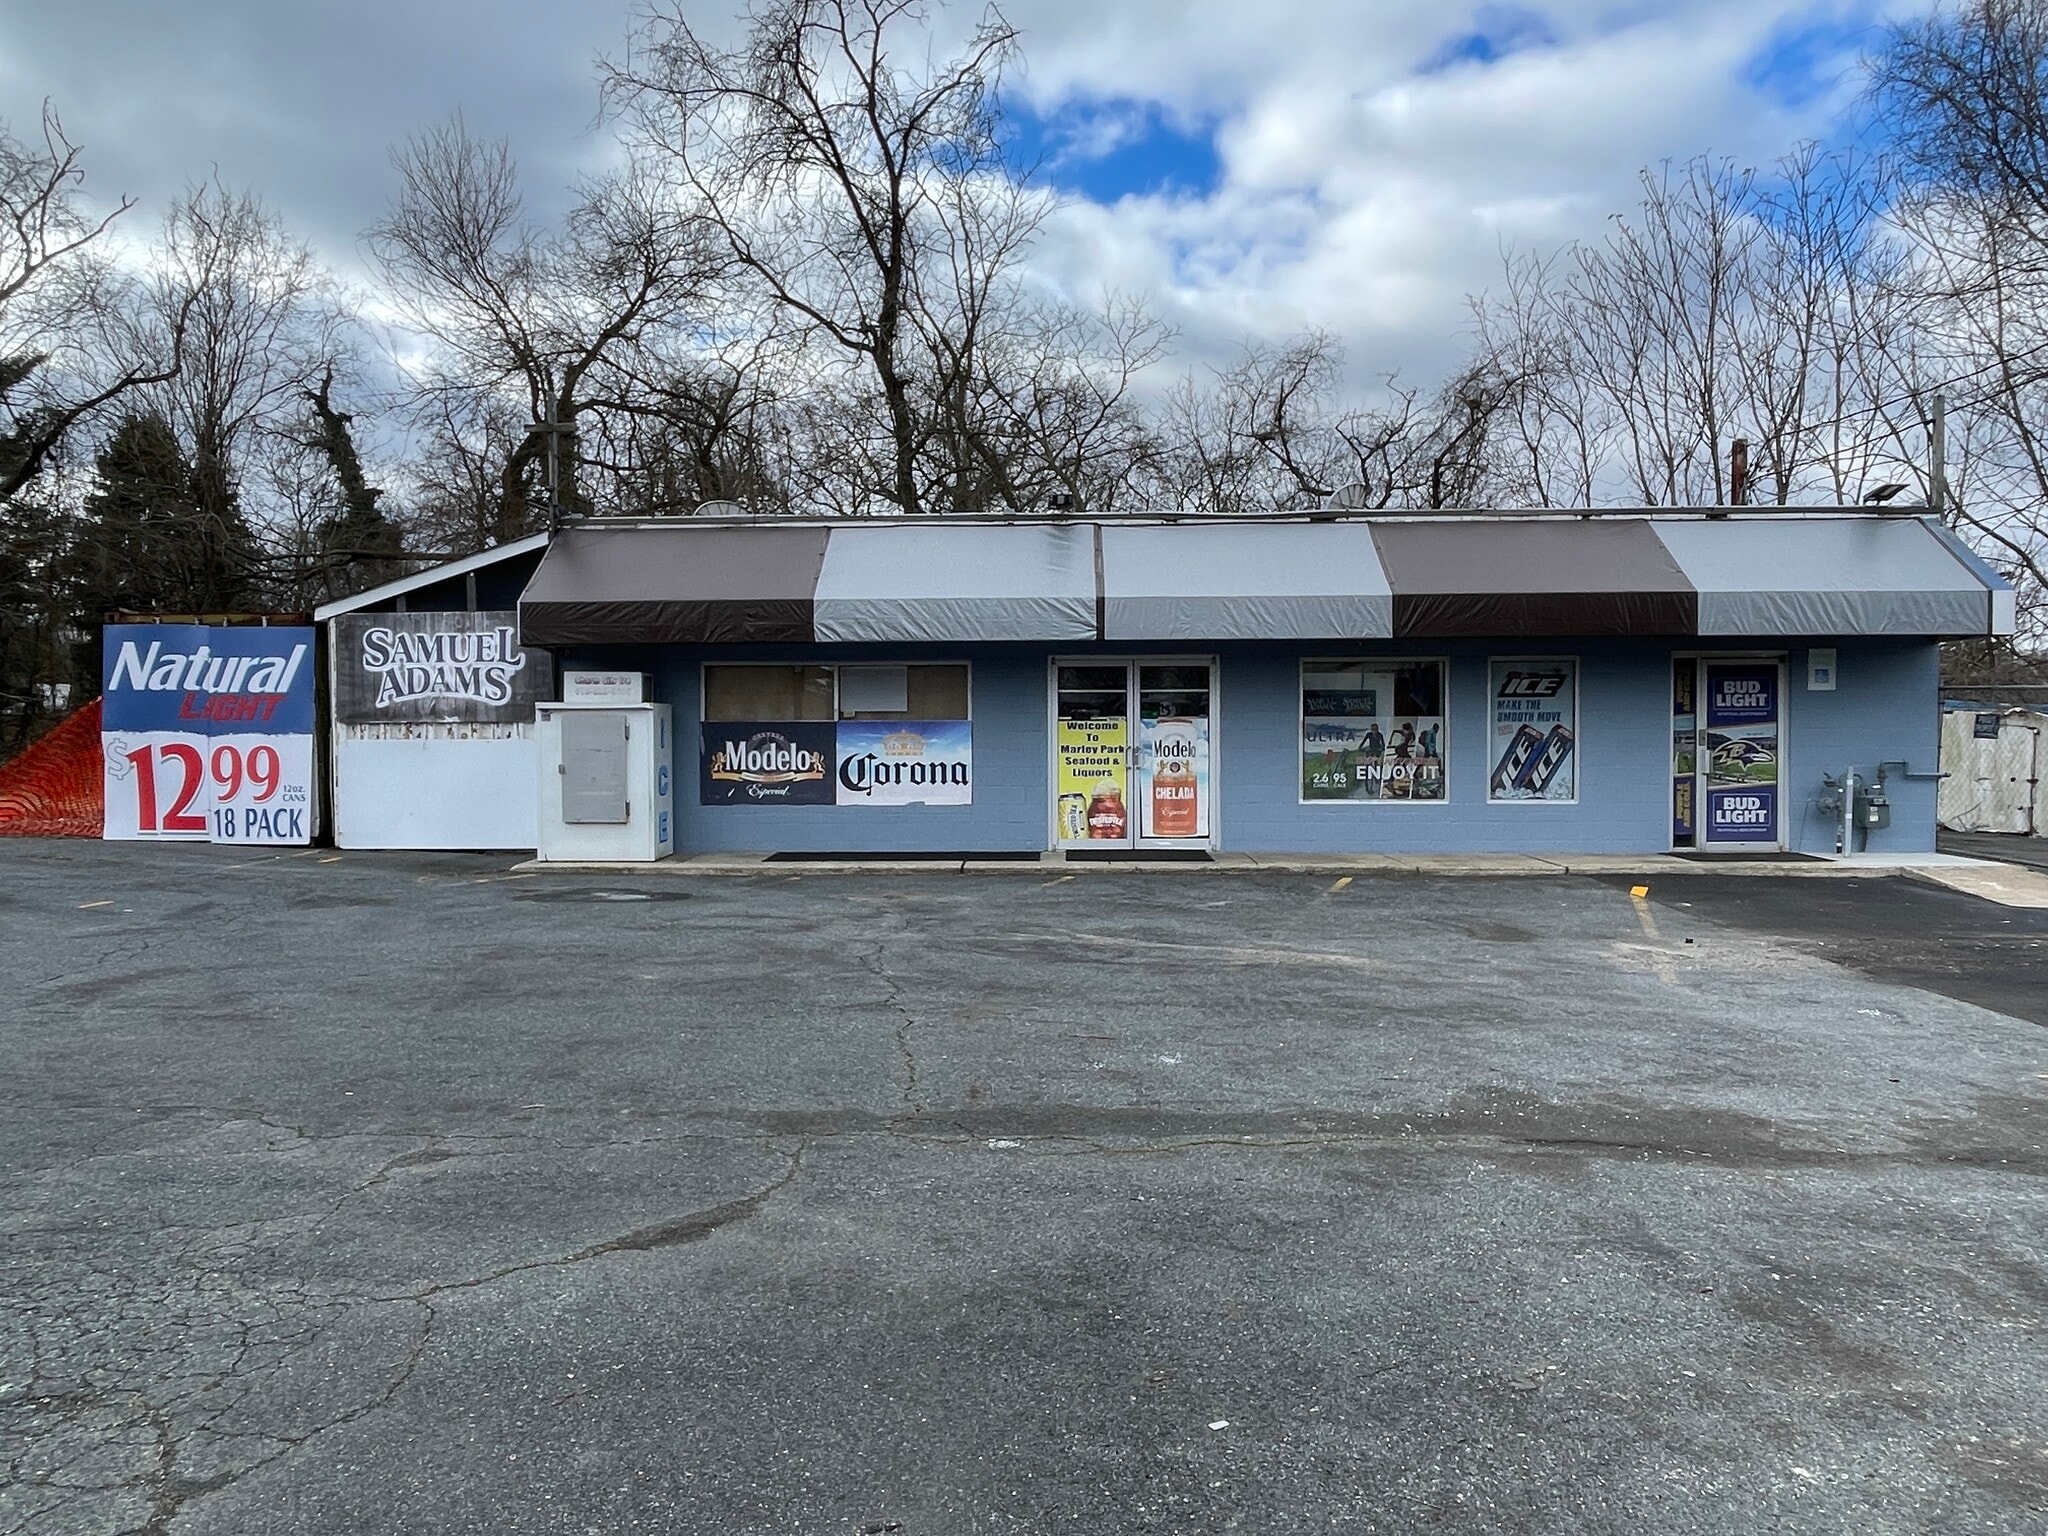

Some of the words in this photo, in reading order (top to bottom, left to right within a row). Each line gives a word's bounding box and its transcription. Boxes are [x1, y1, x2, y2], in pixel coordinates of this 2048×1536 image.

[362, 626, 526, 672] SAMUEL
[108, 641, 307, 694] Natural
[376, 664, 513, 708] ADAMS
[1504, 678, 1560, 694] ICE
[1723, 681, 1761, 694] BUD
[179, 692, 287, 722] LIGHT
[1497, 700, 1522, 710] MAKE
[1525, 700, 1541, 710] THE
[1716, 693, 1768, 707] LIGHT
[1497, 711, 1534, 722] SMOOTH
[1537, 711, 1562, 722] MOVE
[1066, 721, 1119, 730] Welcome
[1086, 733, 1099, 742] To
[1306, 731, 1356, 742] ULTRA
[725, 740, 811, 771] Modelo
[1060, 745, 1098, 754] Marley
[1100, 745, 1125, 754] Park
[1153, 740, 1196, 758] Modelo
[1065, 756, 1110, 765] Seafood
[1501, 735, 1532, 790] ICE
[1531, 736, 1564, 790] ICE
[839, 752, 969, 796] Corona
[1072, 768, 1113, 777] Liquors
[1312, 772, 1329, 783] 2.6
[1332, 772, 1347, 783] 95
[1356, 765, 1418, 780] ENJOY
[1422, 765, 1440, 780] IT
[1155, 786, 1195, 800] CHELADA
[1723, 797, 1761, 810] BUD
[214, 808, 236, 838] 18
[245, 808, 303, 838] PACK
[1716, 810, 1767, 823] LIGHT
